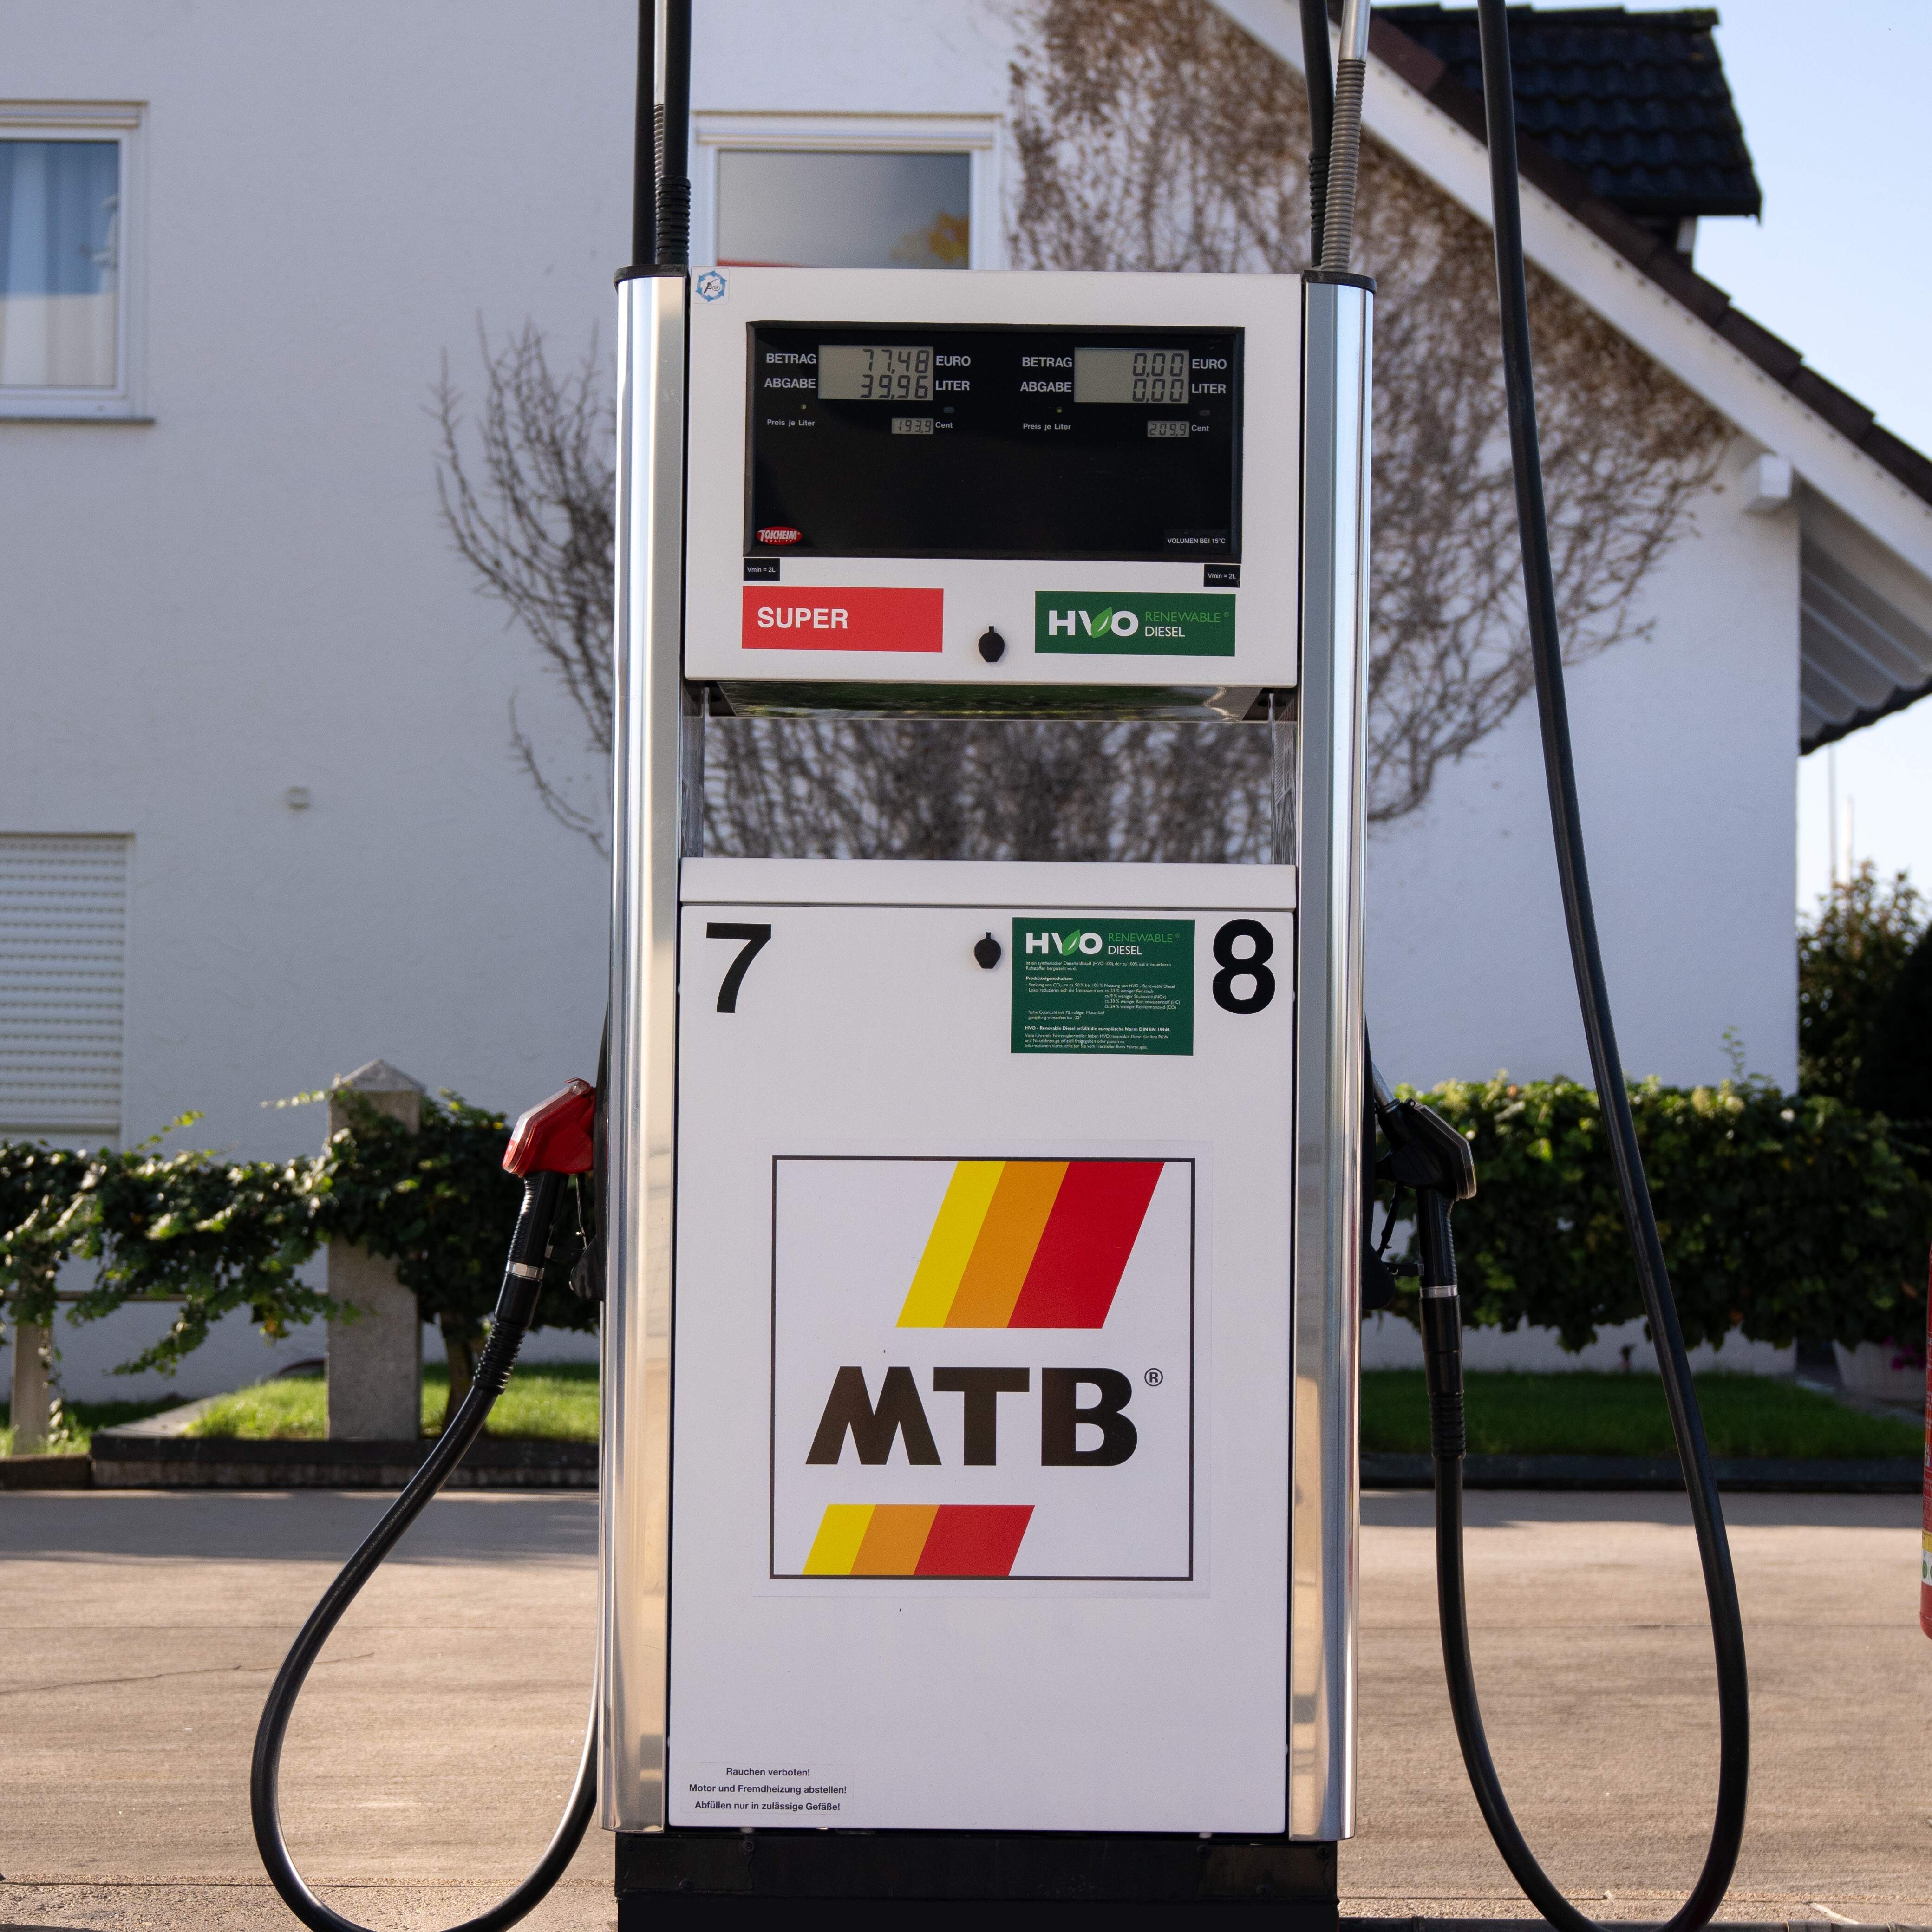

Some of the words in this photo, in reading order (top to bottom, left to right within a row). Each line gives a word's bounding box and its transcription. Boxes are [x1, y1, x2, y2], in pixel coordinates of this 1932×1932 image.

[766, 353, 816, 364] BETRAG
[863, 349, 929, 374] 77,48
[936, 356, 971, 366] EURO
[1023, 357, 1072, 367] BETRAG
[1133, 353, 1184, 377] 0,00
[1193, 359, 1227, 369] EURO
[764, 378, 816, 388] ABGABE
[861, 375, 928, 399] 39,96
[936, 380, 970, 390] LITER
[1020, 382, 1071, 392] ABGABE
[1133, 379, 1184, 403] 0,00
[1192, 384, 1226, 393] LITER
[899, 420, 932, 433] 193,9
[1149, 424, 1186, 437] 209,9
[757, 530, 797, 542] TOKHEIM
[758, 607, 848, 628] SUPER
[1049, 610, 1138, 636] HVO
[1146, 612, 1220, 622] RENEWABLE
[1145, 627, 1185, 637] DIESEL
[1026, 933, 1102, 954] HVO
[1109, 933, 1172, 942] RENEWABLE
[1108, 946, 1142, 954] DIESEL
[706, 922, 771, 1013] 7
[1213, 917, 1275, 1014] 8
[805, 1366, 1138, 1467] MTB
[738, 1785, 801, 1795] Fremdheizung
[762, 1802, 803, 1811] zulässige
